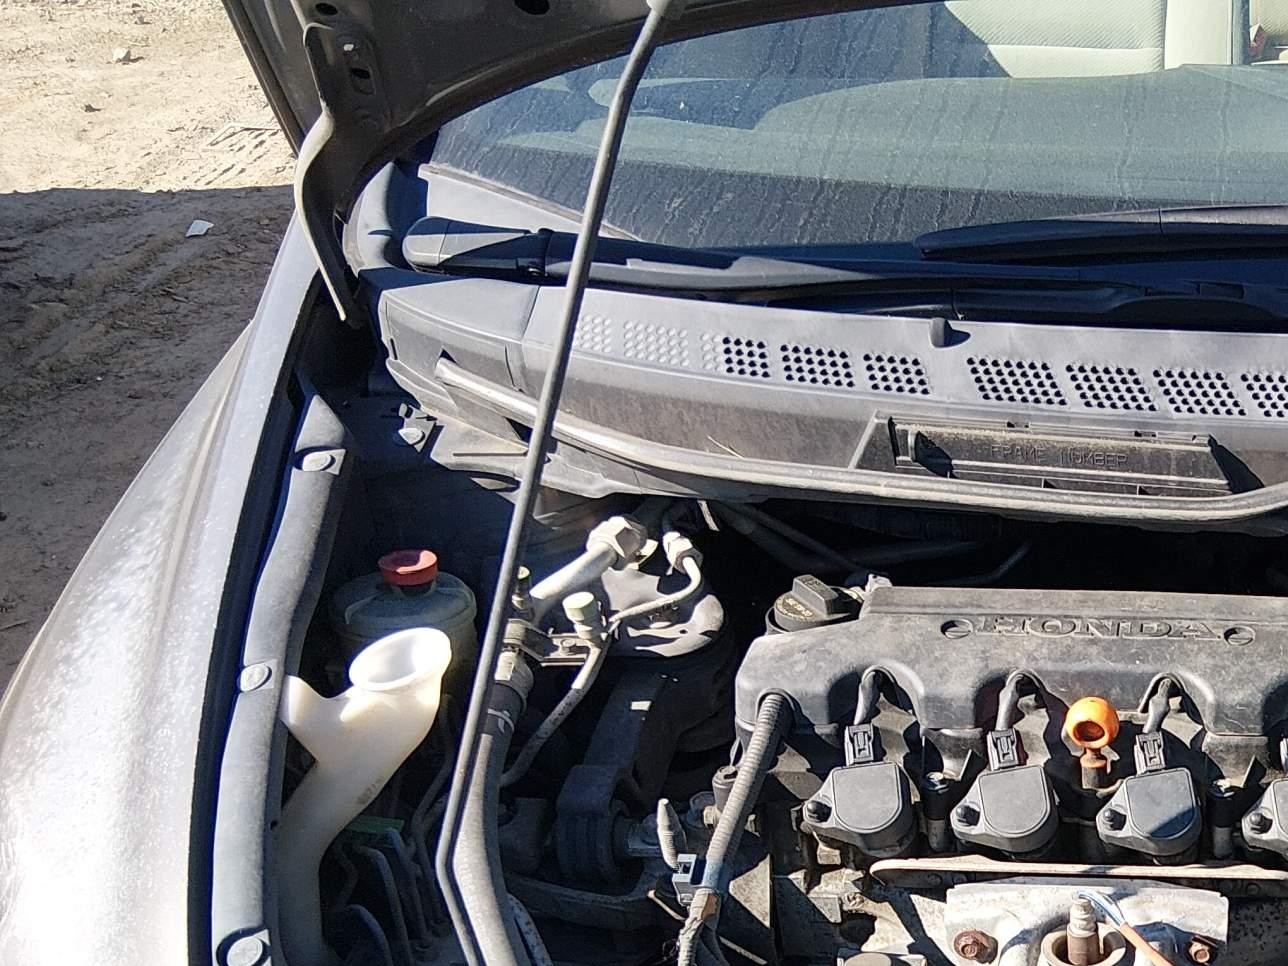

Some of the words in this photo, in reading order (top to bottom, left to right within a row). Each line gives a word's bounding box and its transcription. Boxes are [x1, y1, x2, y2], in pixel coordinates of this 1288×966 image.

[990, 444, 1047, 460] FRAME
[1060, 447, 1128, 467] NUMBER
[977, 617, 1220, 639] HONDA
